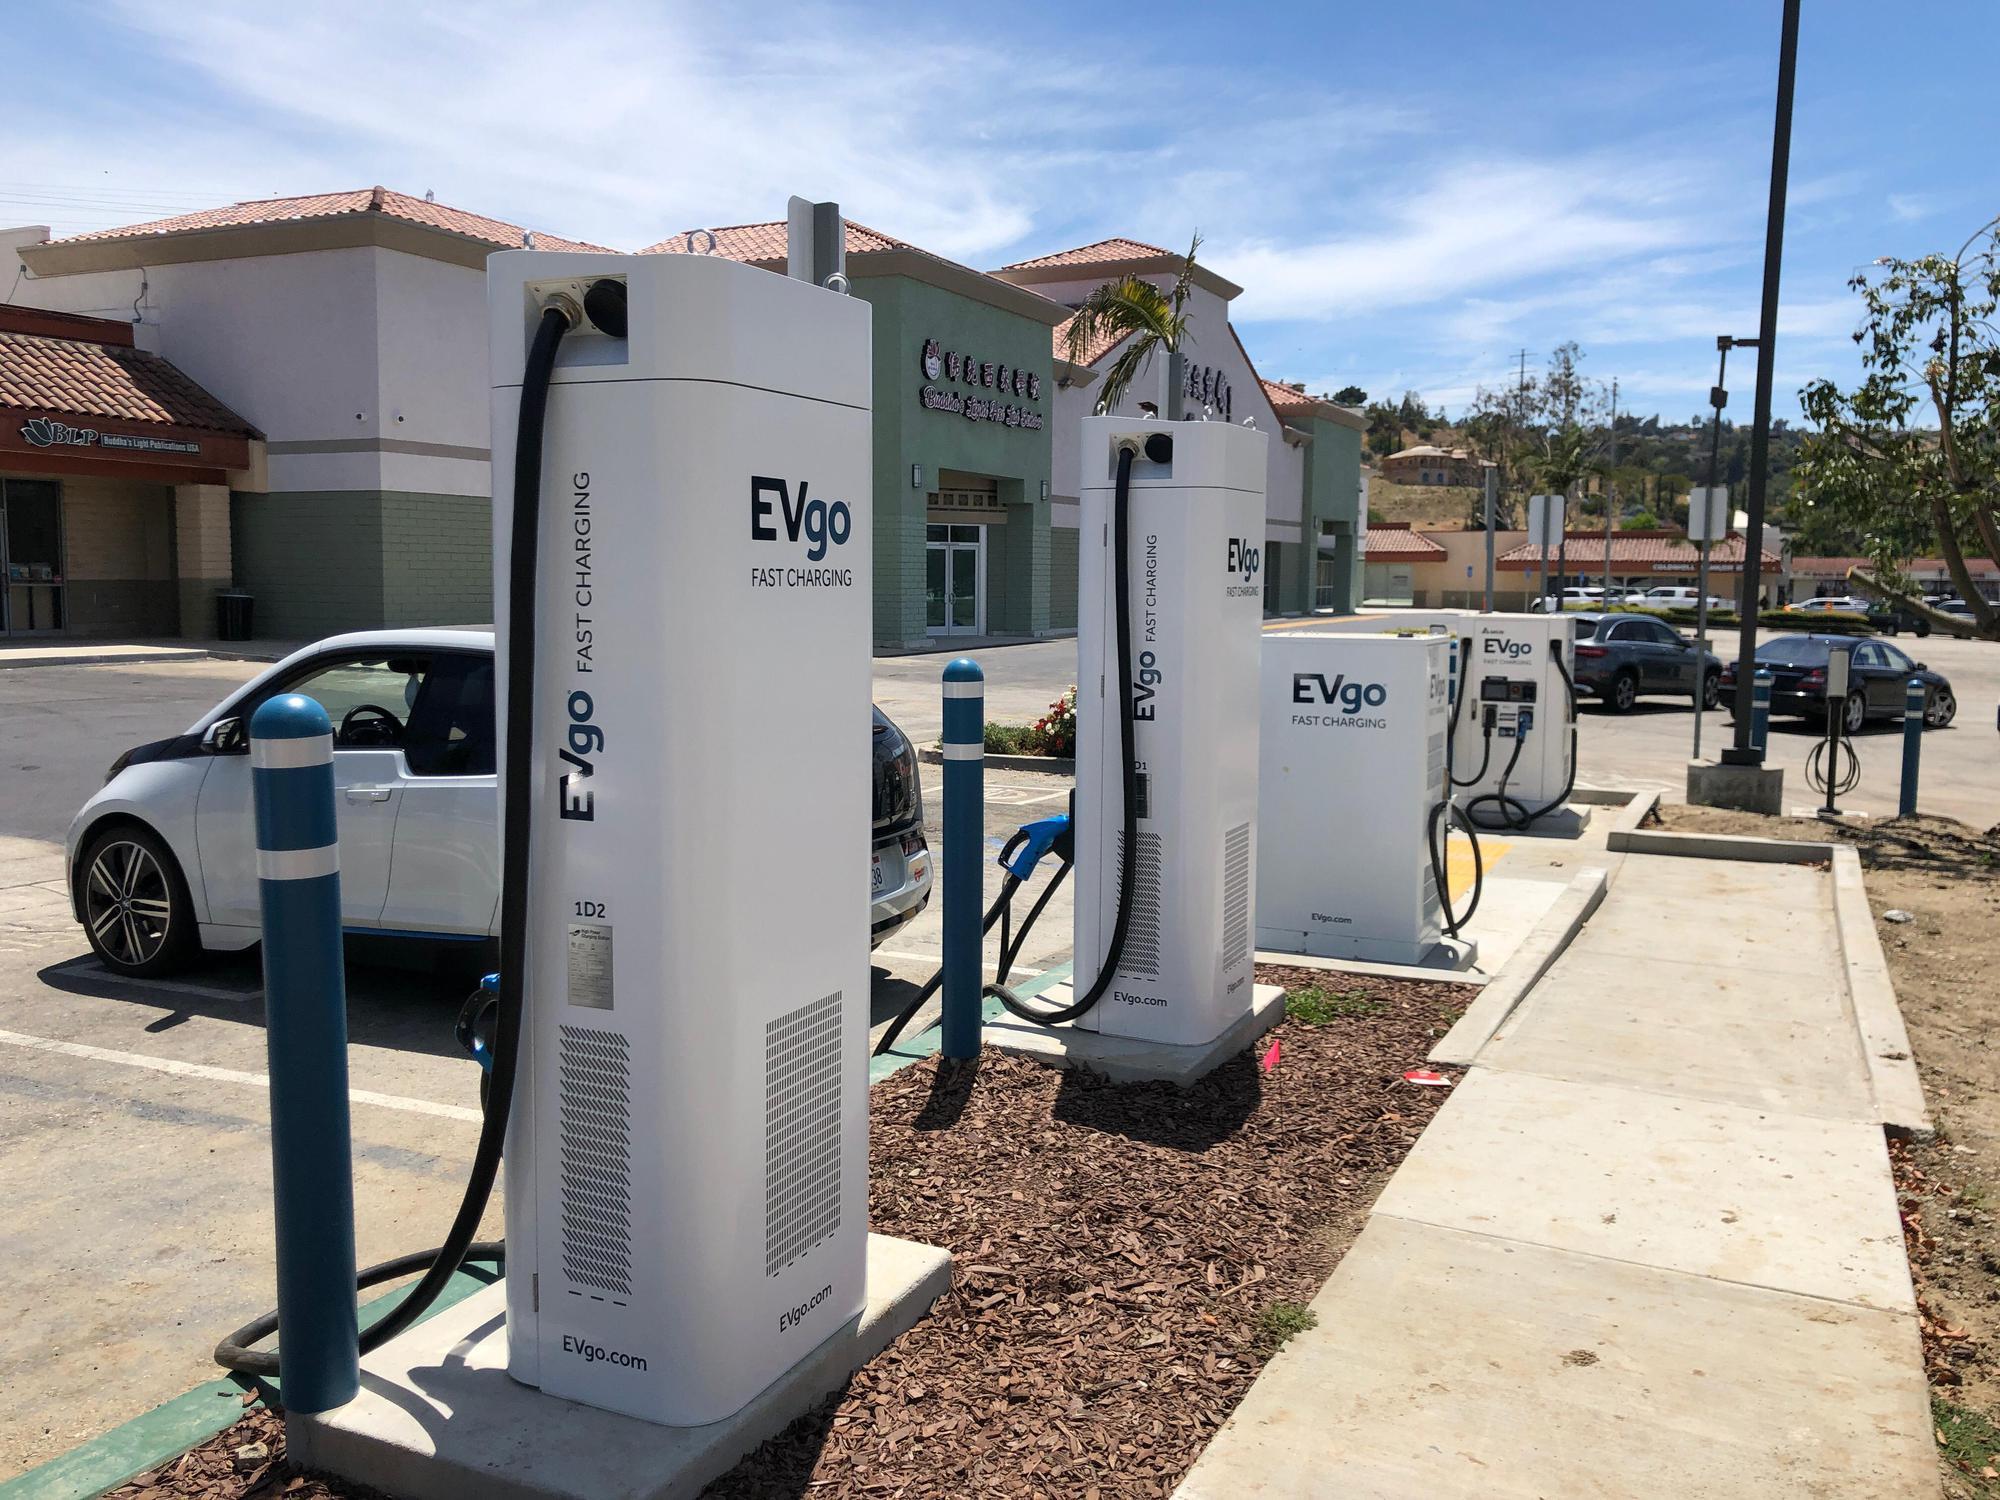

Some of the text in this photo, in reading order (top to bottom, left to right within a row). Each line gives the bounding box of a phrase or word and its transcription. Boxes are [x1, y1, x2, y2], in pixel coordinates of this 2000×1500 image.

[51, 422, 98, 447] BLP
[104, 435, 200, 453] Buddha's Light Publications USA
[751, 475, 852, 562] EVgo
[1227, 537, 1260, 582] EVgo
[751, 568, 852, 588] FAST CHARGING
[1226, 586, 1259, 597] FAST CHARGING
[1133, 534, 1162, 722] EVgo FAST CHARGING
[560, 472, 605, 822] EVgo FAST CHARGING
[1484, 638, 1532, 658] EVgo
[1293, 673, 1387, 714] EVgo
[1292, 715, 1386, 729] FAST CHARGING
[575, 901, 606, 918] 1D2
[1311, 912, 1352, 925] EVgo.com
[1113, 991, 1168, 1007] EVgo.com
[779, 1283, 833, 1334] EVgo.com
[563, 1335, 648, 1372] EVgo.com
